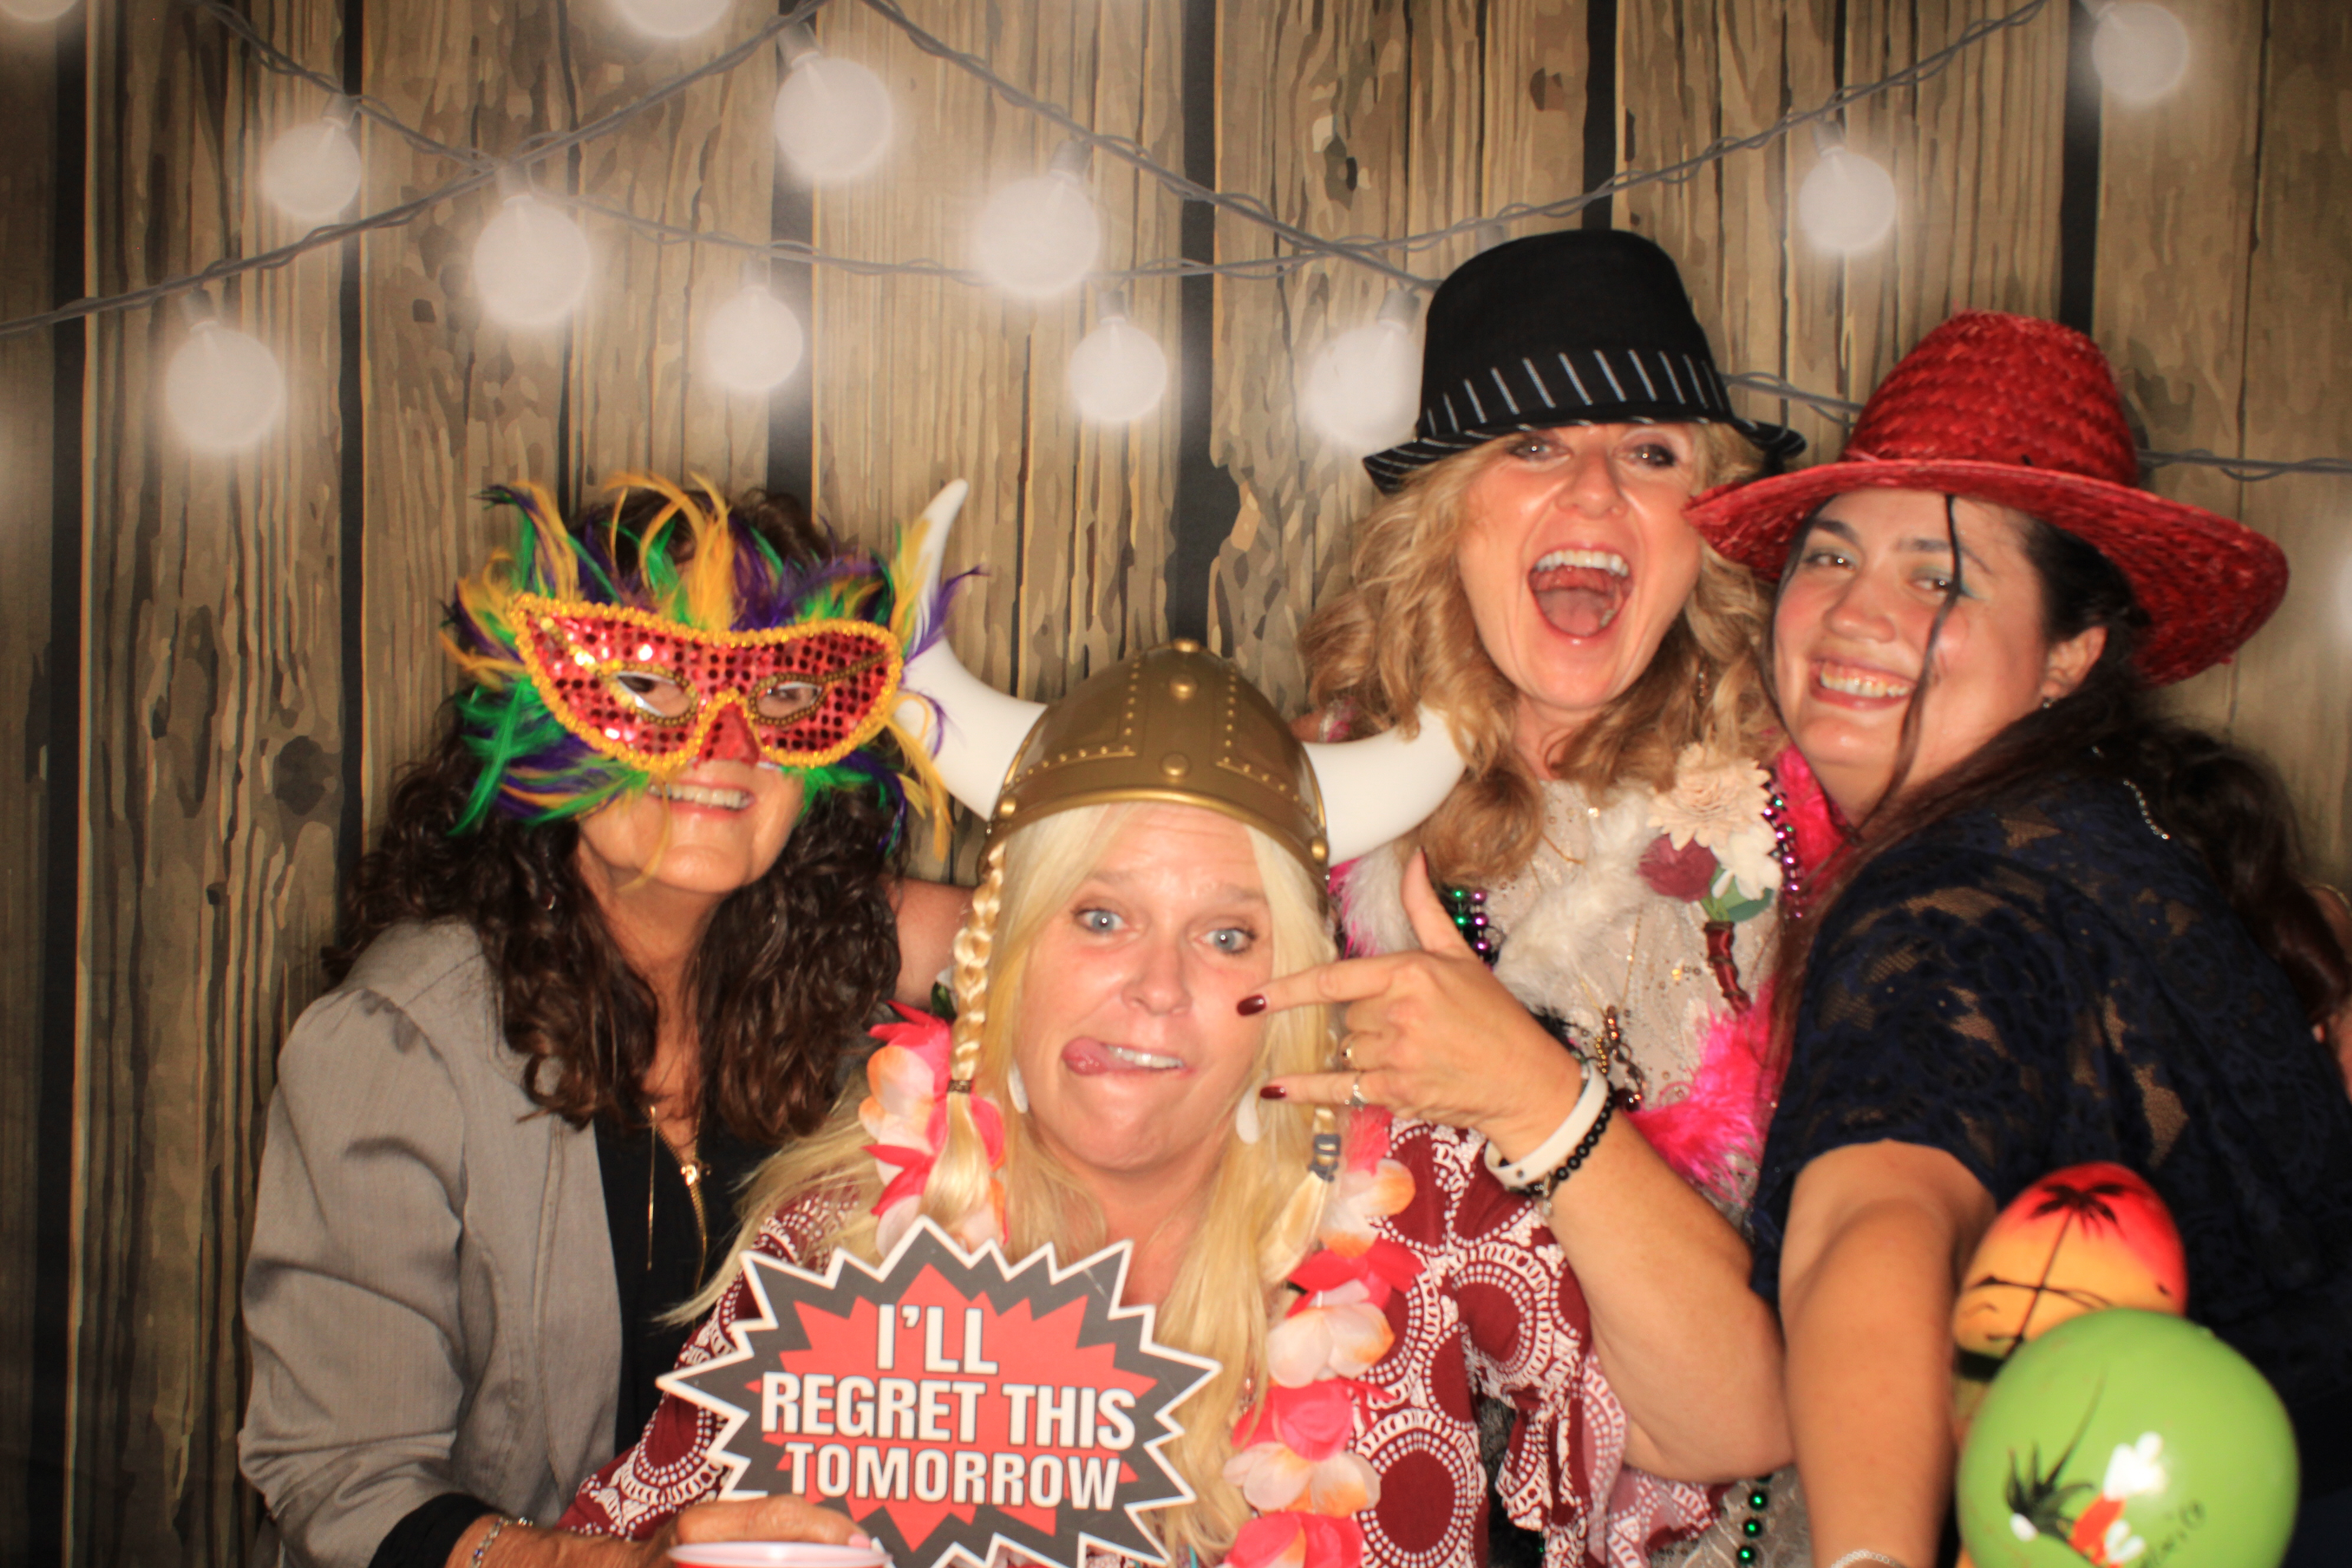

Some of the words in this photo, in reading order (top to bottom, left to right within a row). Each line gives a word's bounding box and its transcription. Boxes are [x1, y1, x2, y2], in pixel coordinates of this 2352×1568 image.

[877, 1304, 998, 1374] I'LL
[762, 1371, 985, 1442] REGRET
[1002, 1384, 1136, 1449] THIS
[786, 1442, 1120, 1510] TOMORROW
